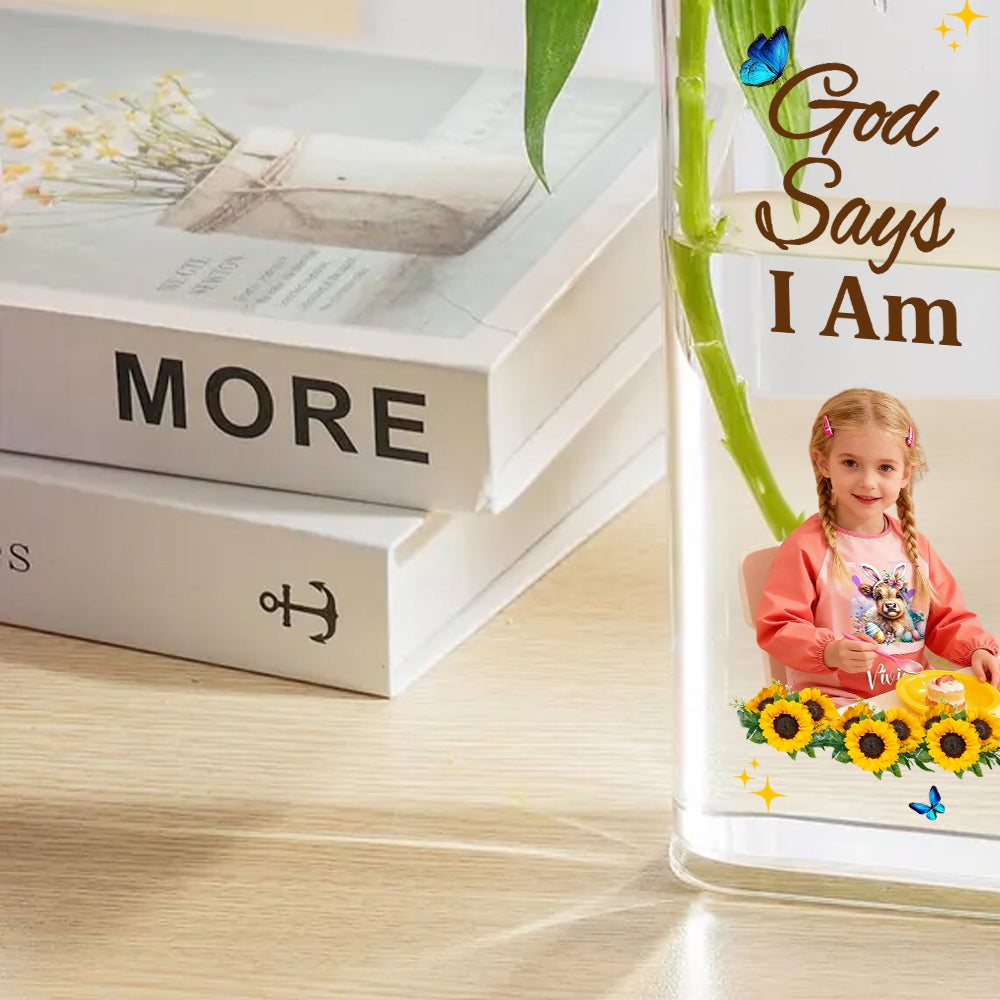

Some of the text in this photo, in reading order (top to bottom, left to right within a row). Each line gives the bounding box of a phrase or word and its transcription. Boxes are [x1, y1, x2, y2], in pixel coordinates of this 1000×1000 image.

[768, 62, 940, 156] God
[755, 157, 955, 275] Says
[769, 270, 962, 347] I Am
[114, 350, 430, 465] MORE
